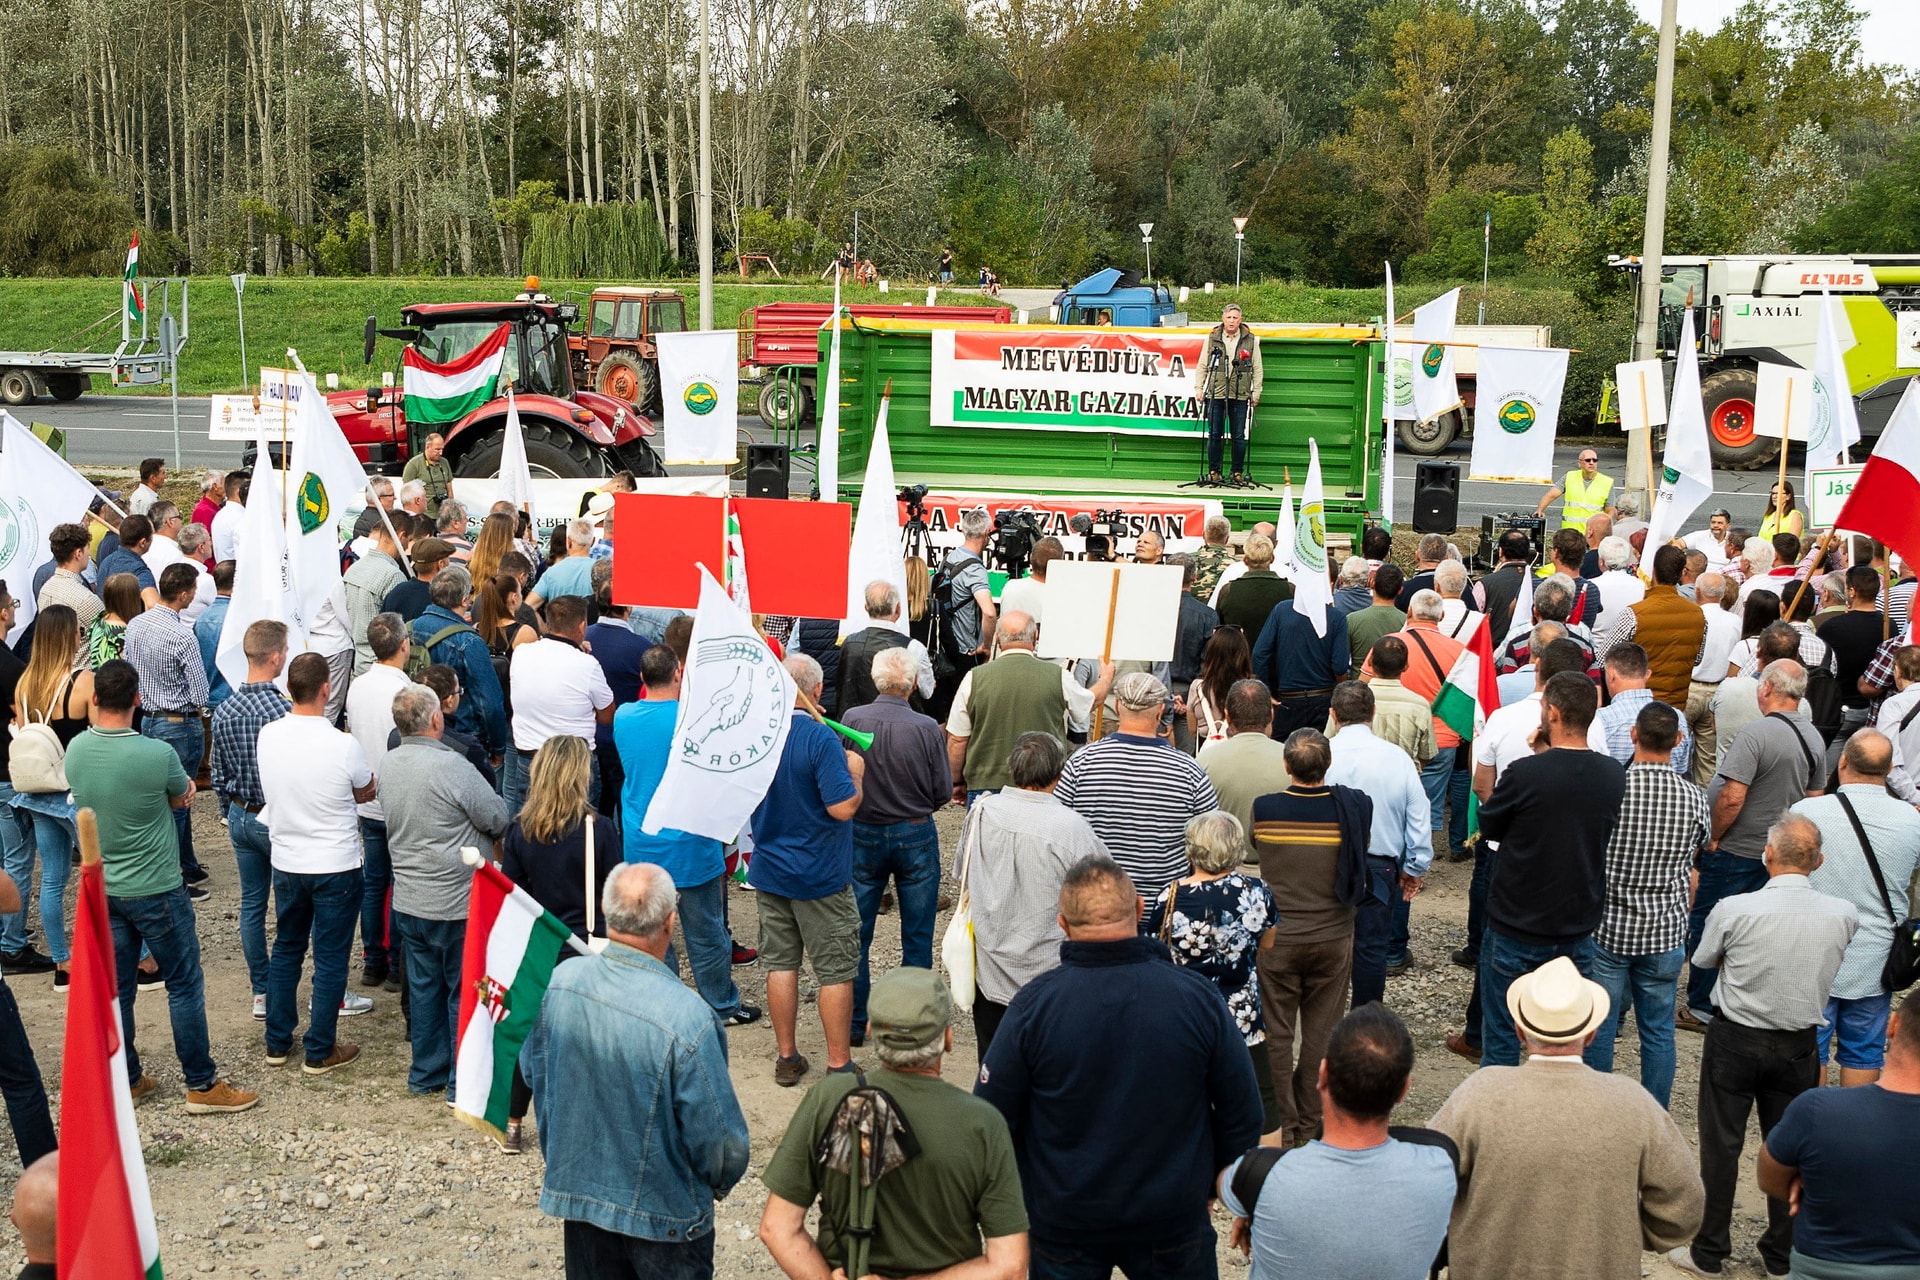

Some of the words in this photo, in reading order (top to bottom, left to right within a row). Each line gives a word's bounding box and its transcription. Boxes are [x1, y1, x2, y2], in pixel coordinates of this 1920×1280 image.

[1752, 304, 1803, 317] AXIÁL
[1001, 345, 1160, 377] MEGVÉDJÜK
[1167, 355, 1186, 378] A
[964, 386, 1072, 413] MAGYAR
[1079, 390, 1207, 419] GAZDÁKA
[1825, 480, 1854, 497] Jás
[929, 508, 948, 532] A
